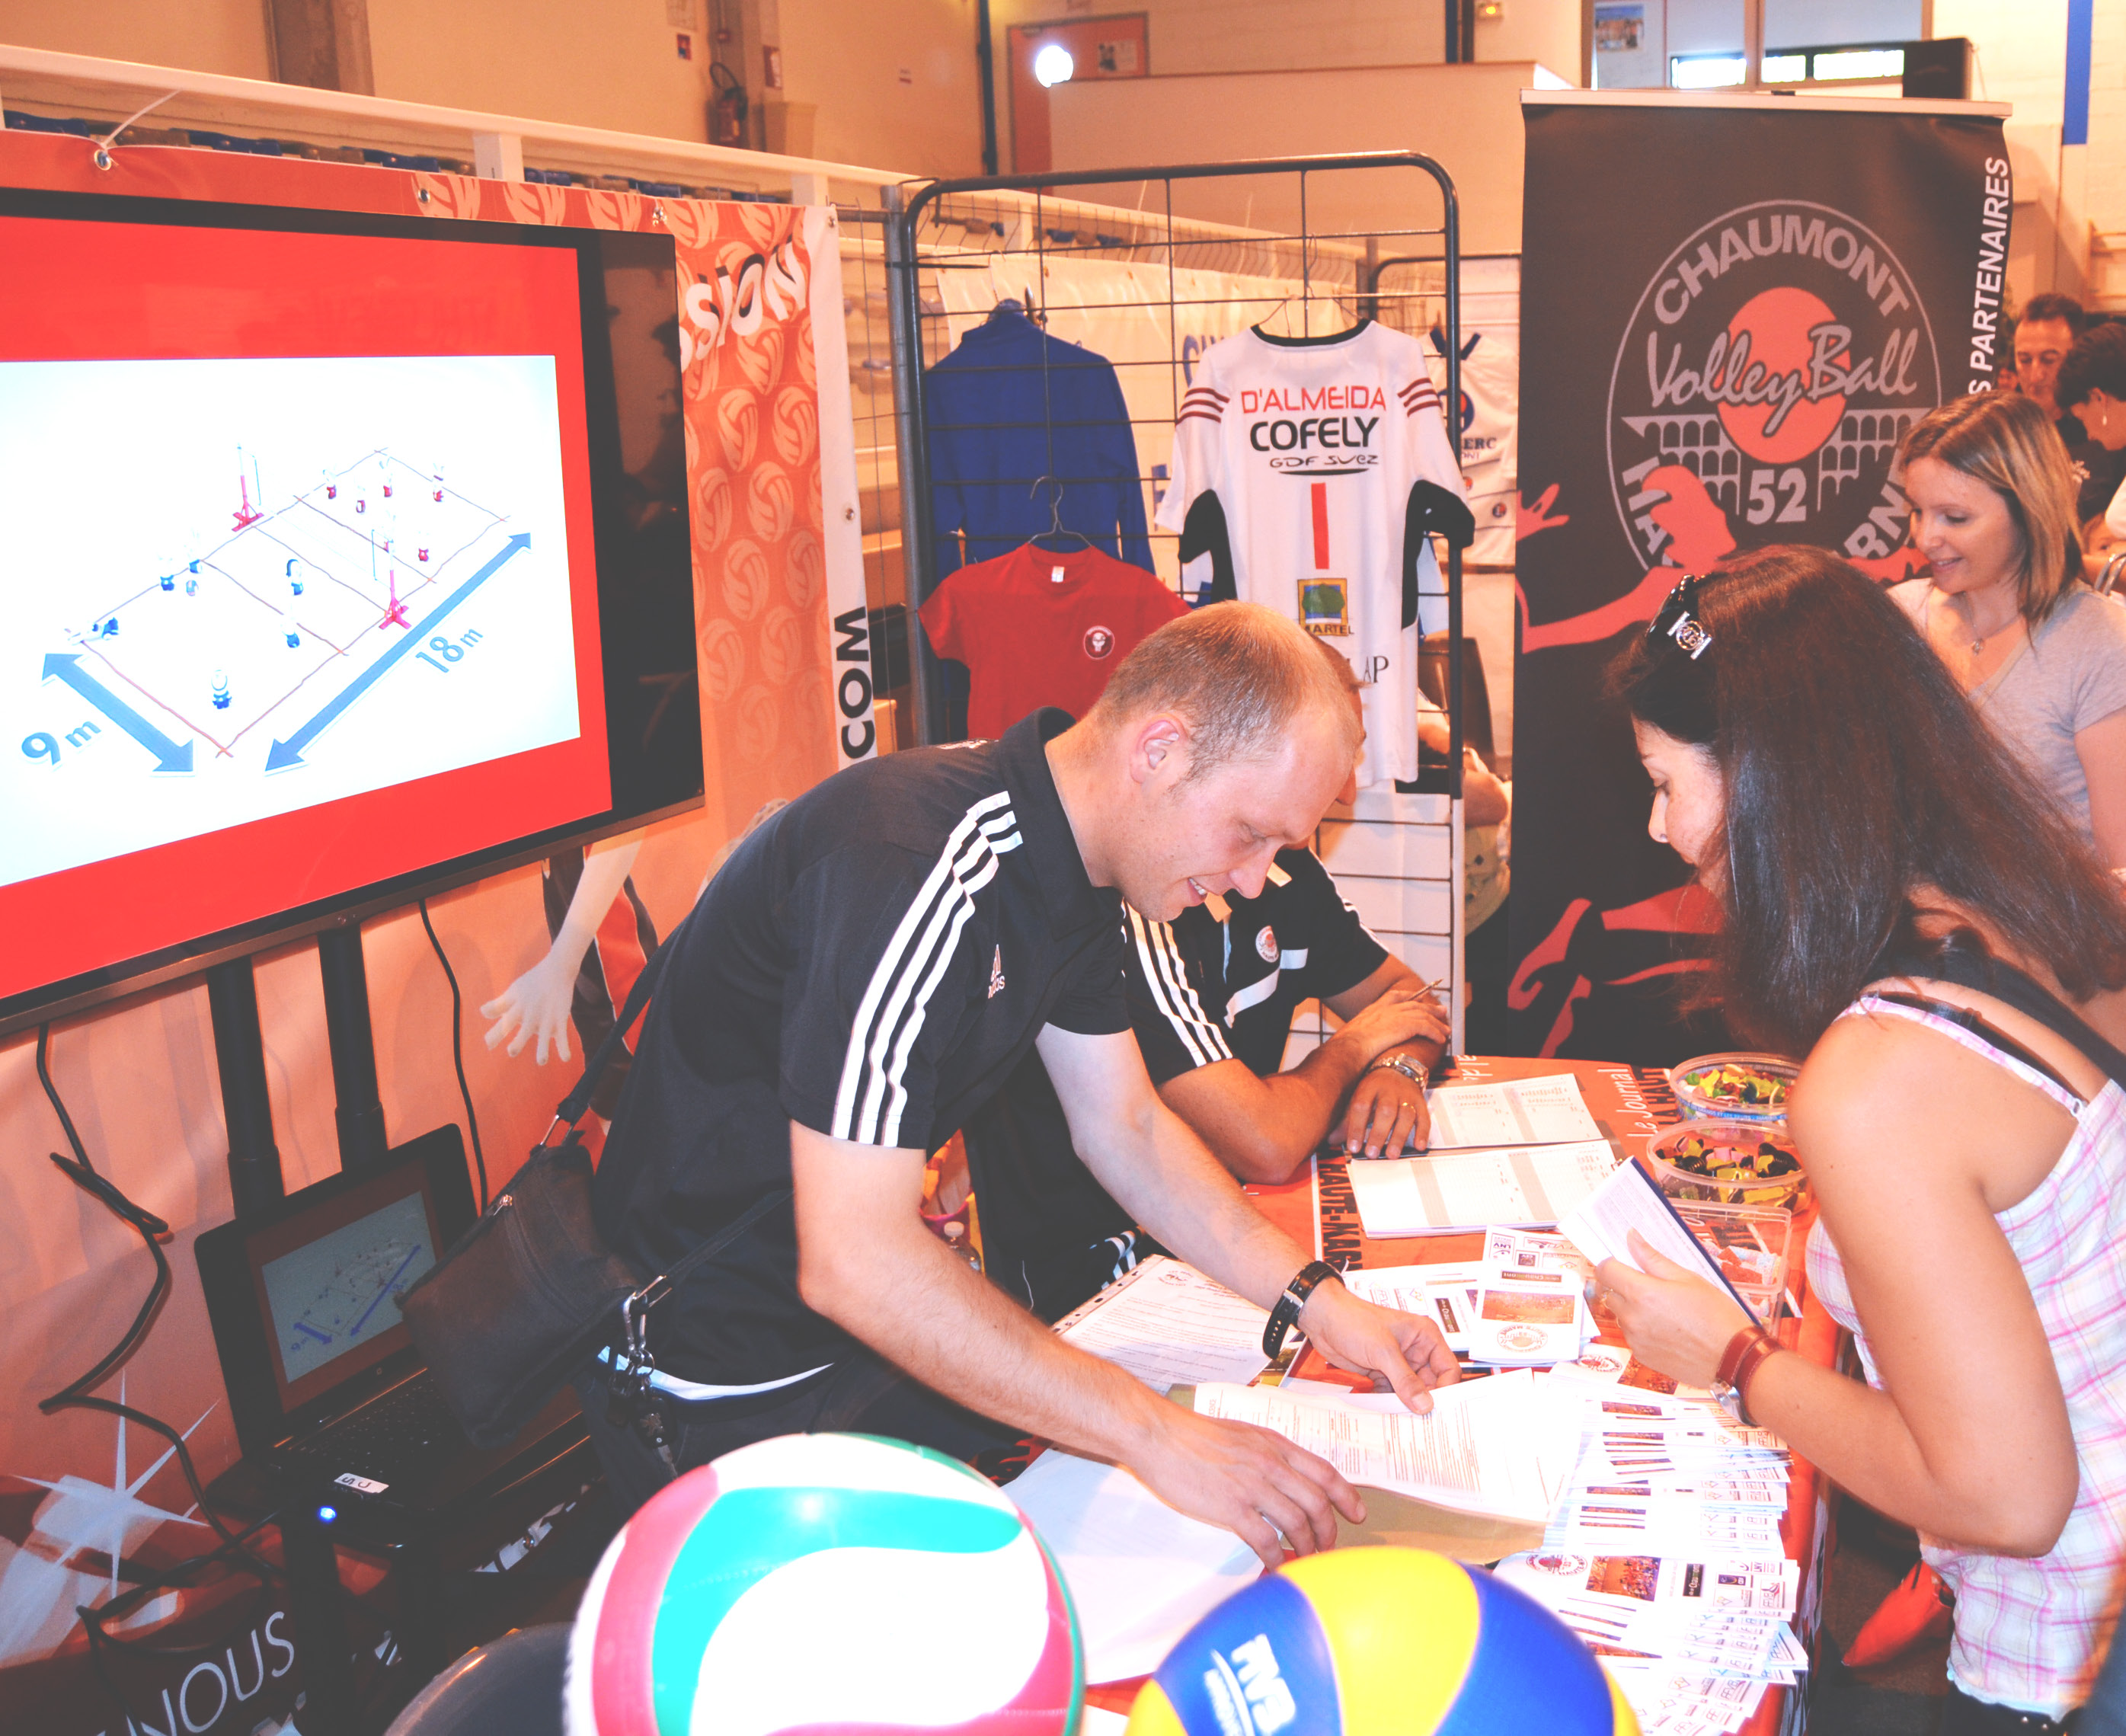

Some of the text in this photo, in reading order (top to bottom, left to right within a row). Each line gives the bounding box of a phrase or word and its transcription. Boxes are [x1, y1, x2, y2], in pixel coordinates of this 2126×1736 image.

[1654, 214, 1910, 324] CHAUMONT
[1971, 157, 2009, 372] PARTENAIRES
[1241, 385, 1386, 414] D'ALMEIDA
[1249, 416, 1380, 452] COFELY
[1269, 456, 1316, 468] GDF
[1747, 468, 1807, 525] 52
[415, 628, 485, 673] 18 m
[835, 606, 876, 759] COM
[21, 718, 102, 767] 9 m
[1597, 1068, 1658, 1137] Le Journal
